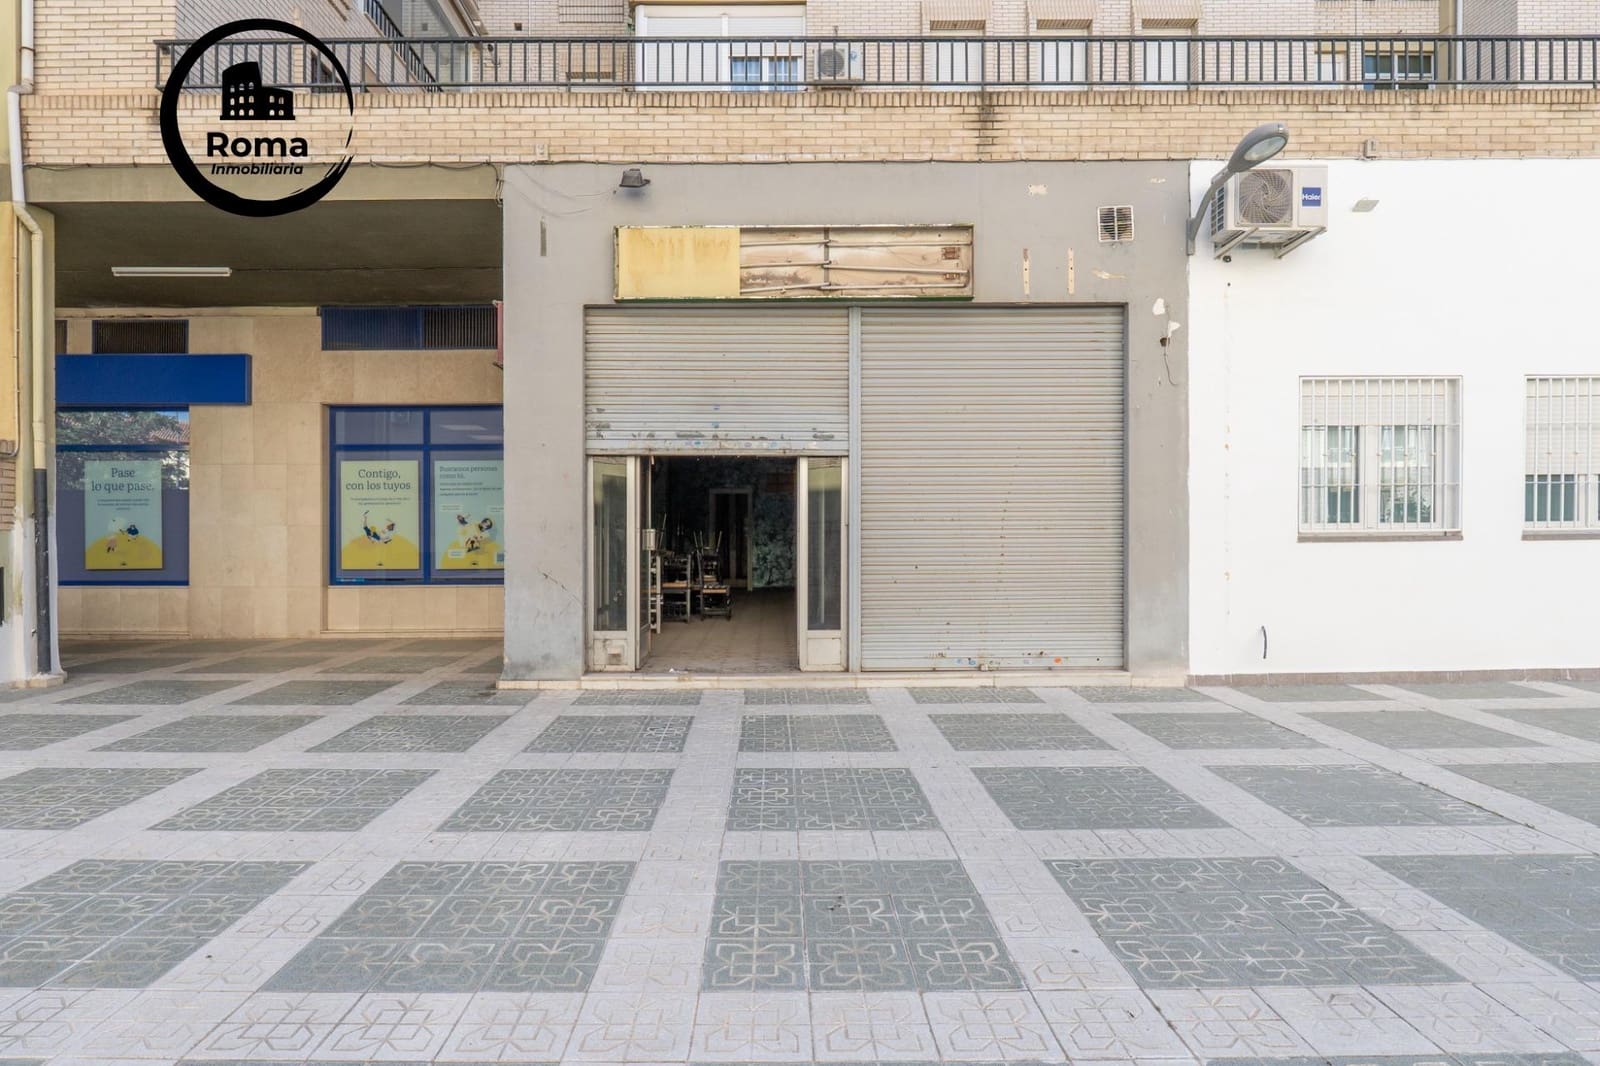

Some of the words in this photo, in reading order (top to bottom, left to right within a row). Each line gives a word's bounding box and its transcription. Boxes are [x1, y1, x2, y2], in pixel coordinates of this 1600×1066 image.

[111, 467, 135, 478] Pase
[358, 468, 401, 480] Contigo,
[91, 480, 102, 491] lo
[104, 482, 125, 493] que
[346, 482, 364, 490] con
[366, 480, 381, 490] los
